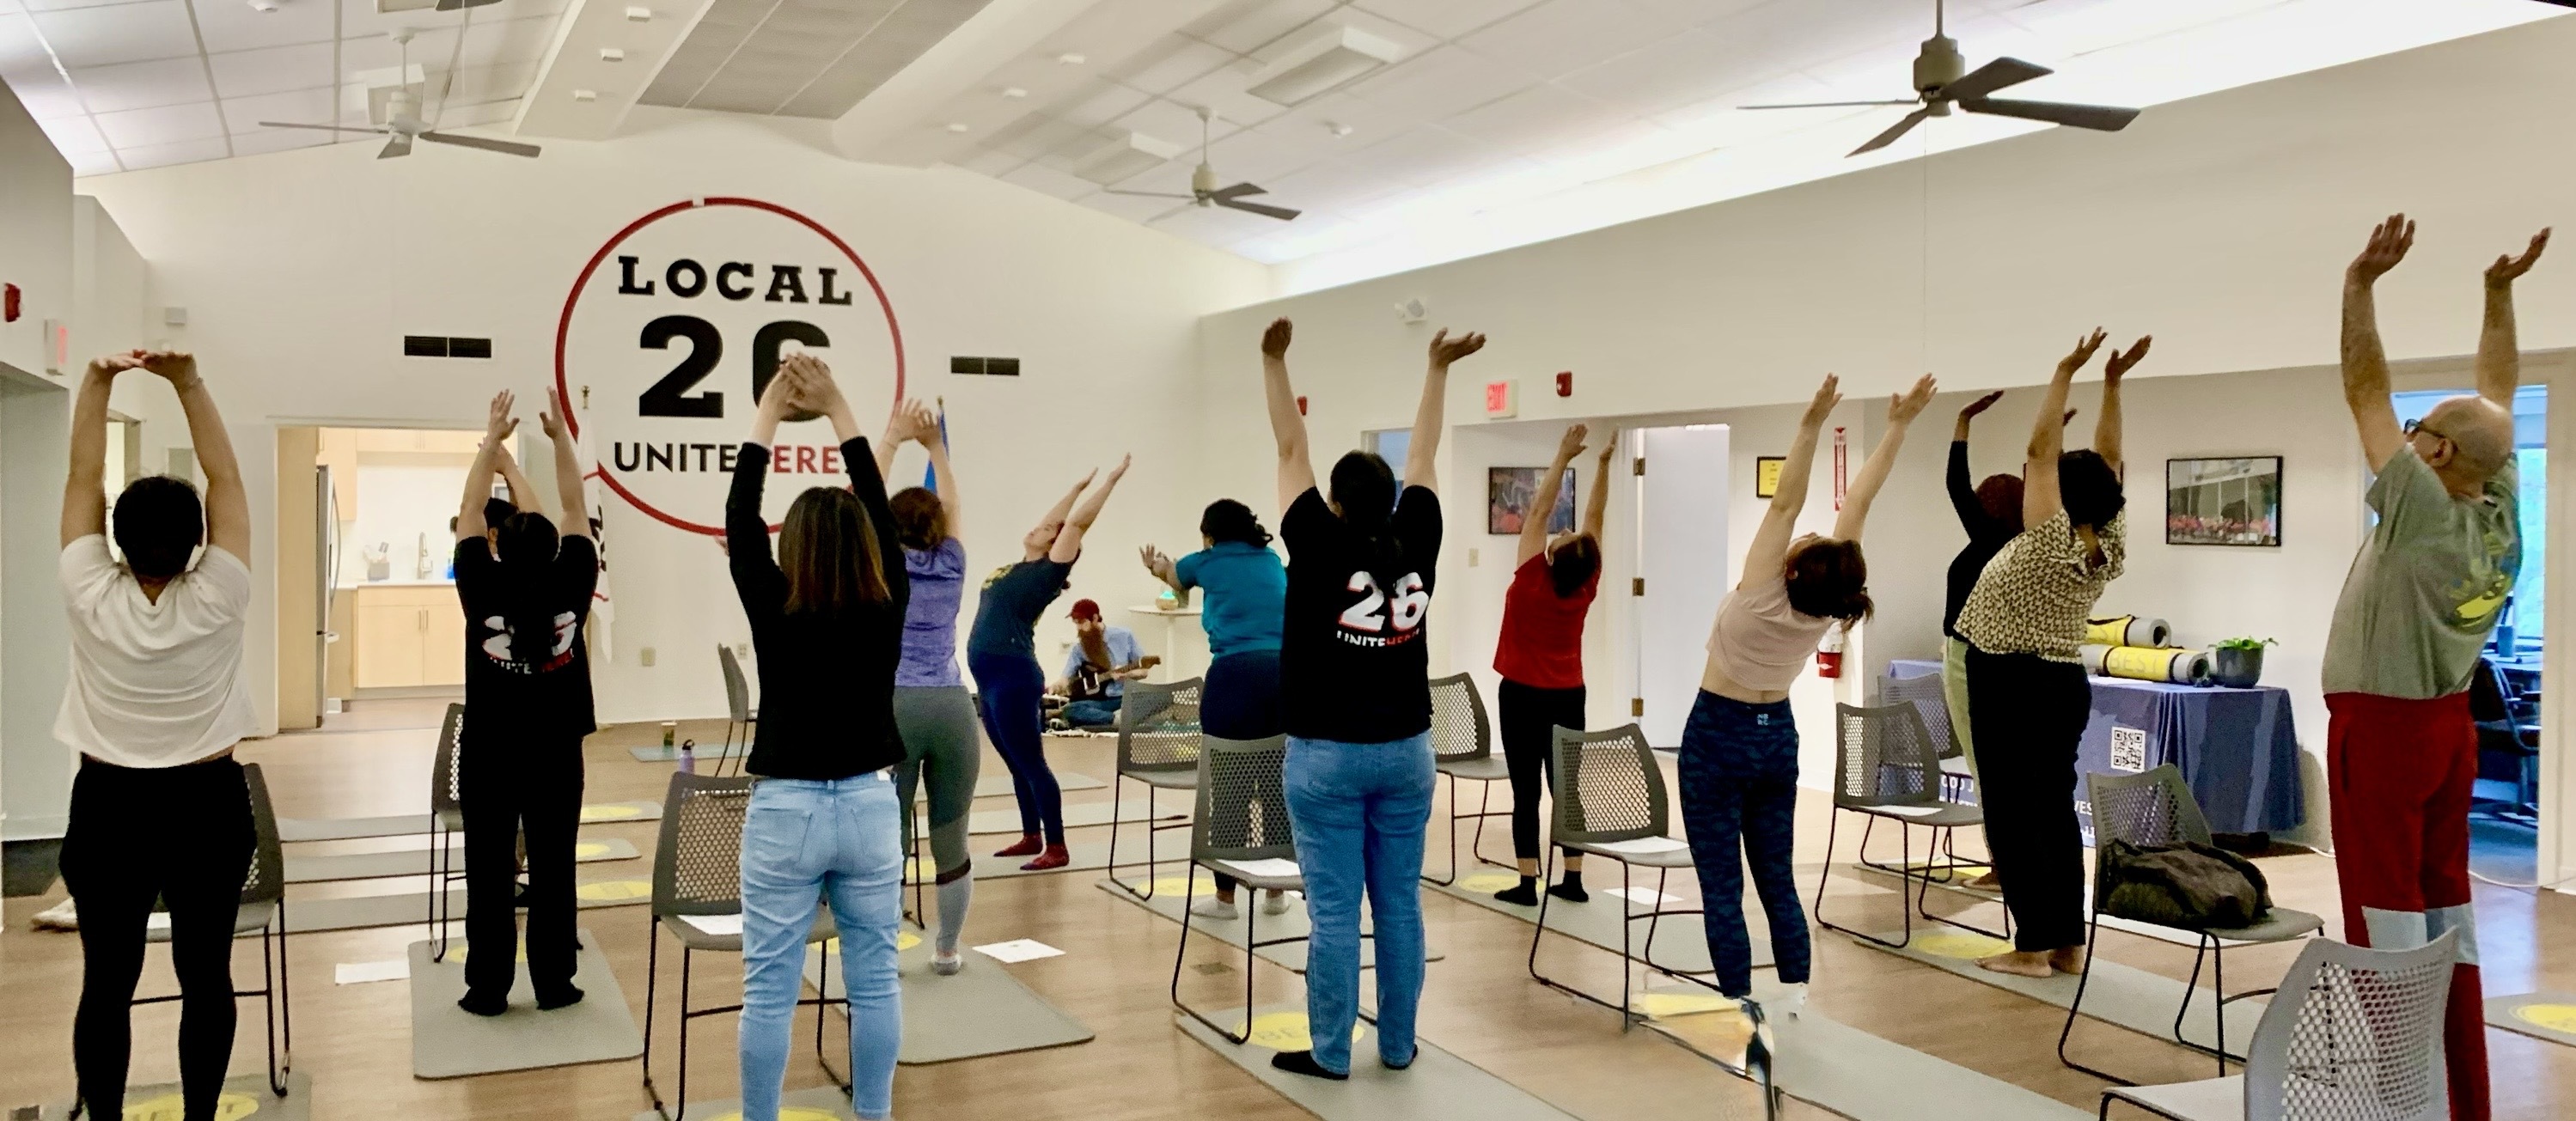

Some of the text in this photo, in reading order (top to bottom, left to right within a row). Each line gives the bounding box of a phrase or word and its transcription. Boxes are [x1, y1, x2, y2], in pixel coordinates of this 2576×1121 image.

[618, 255, 852, 306] LOCAL
[638, 314, 831, 422] 26
[613, 442, 840, 473] UNITEERE
[1339, 570, 1430, 632] 26
[2109, 650, 2161, 674] BEST
